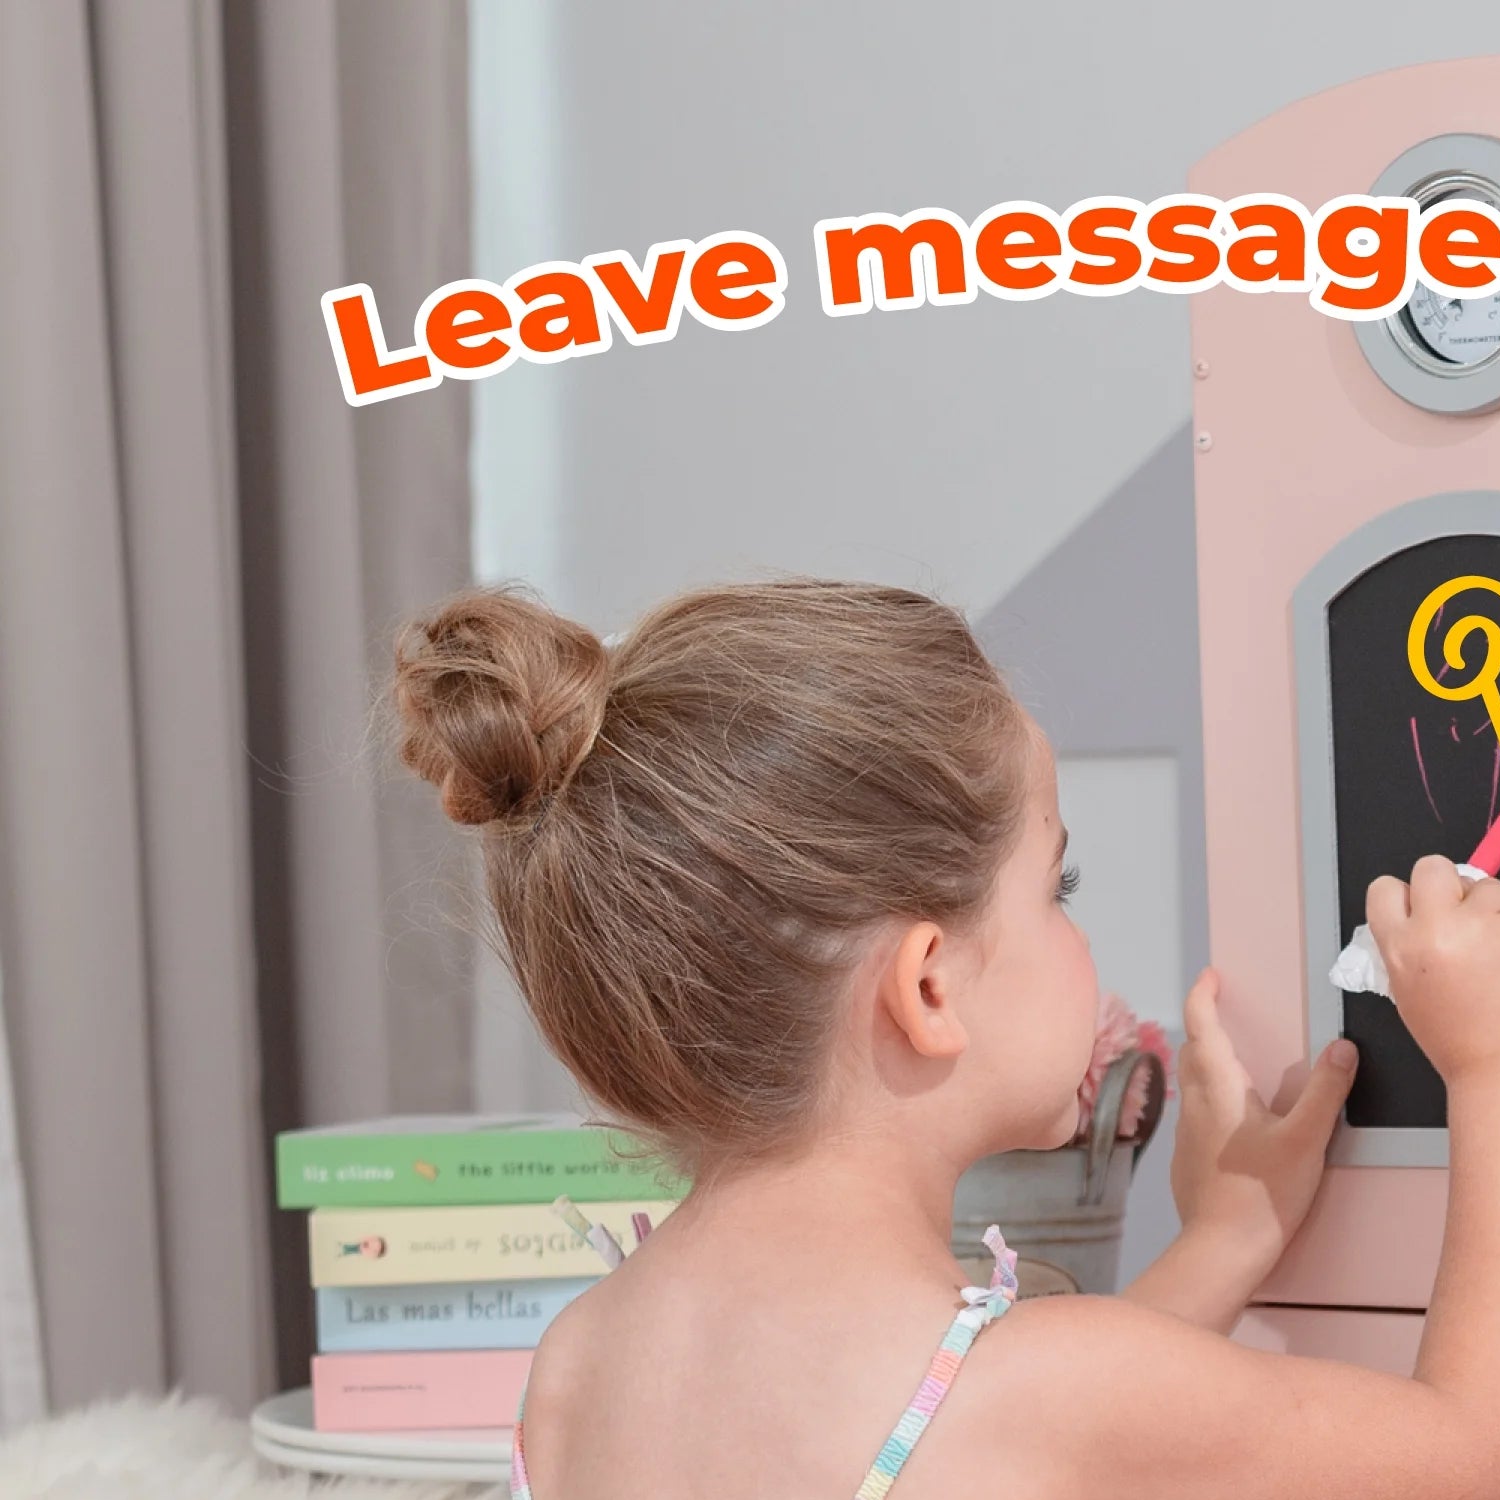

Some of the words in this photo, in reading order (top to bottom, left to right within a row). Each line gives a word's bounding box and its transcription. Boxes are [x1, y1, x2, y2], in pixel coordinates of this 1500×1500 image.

[458, 1162, 494, 1177] the
[502, 1160, 555, 1176] little
[344, 1297, 390, 1324] Las
[465, 1289, 543, 1321] bellas
